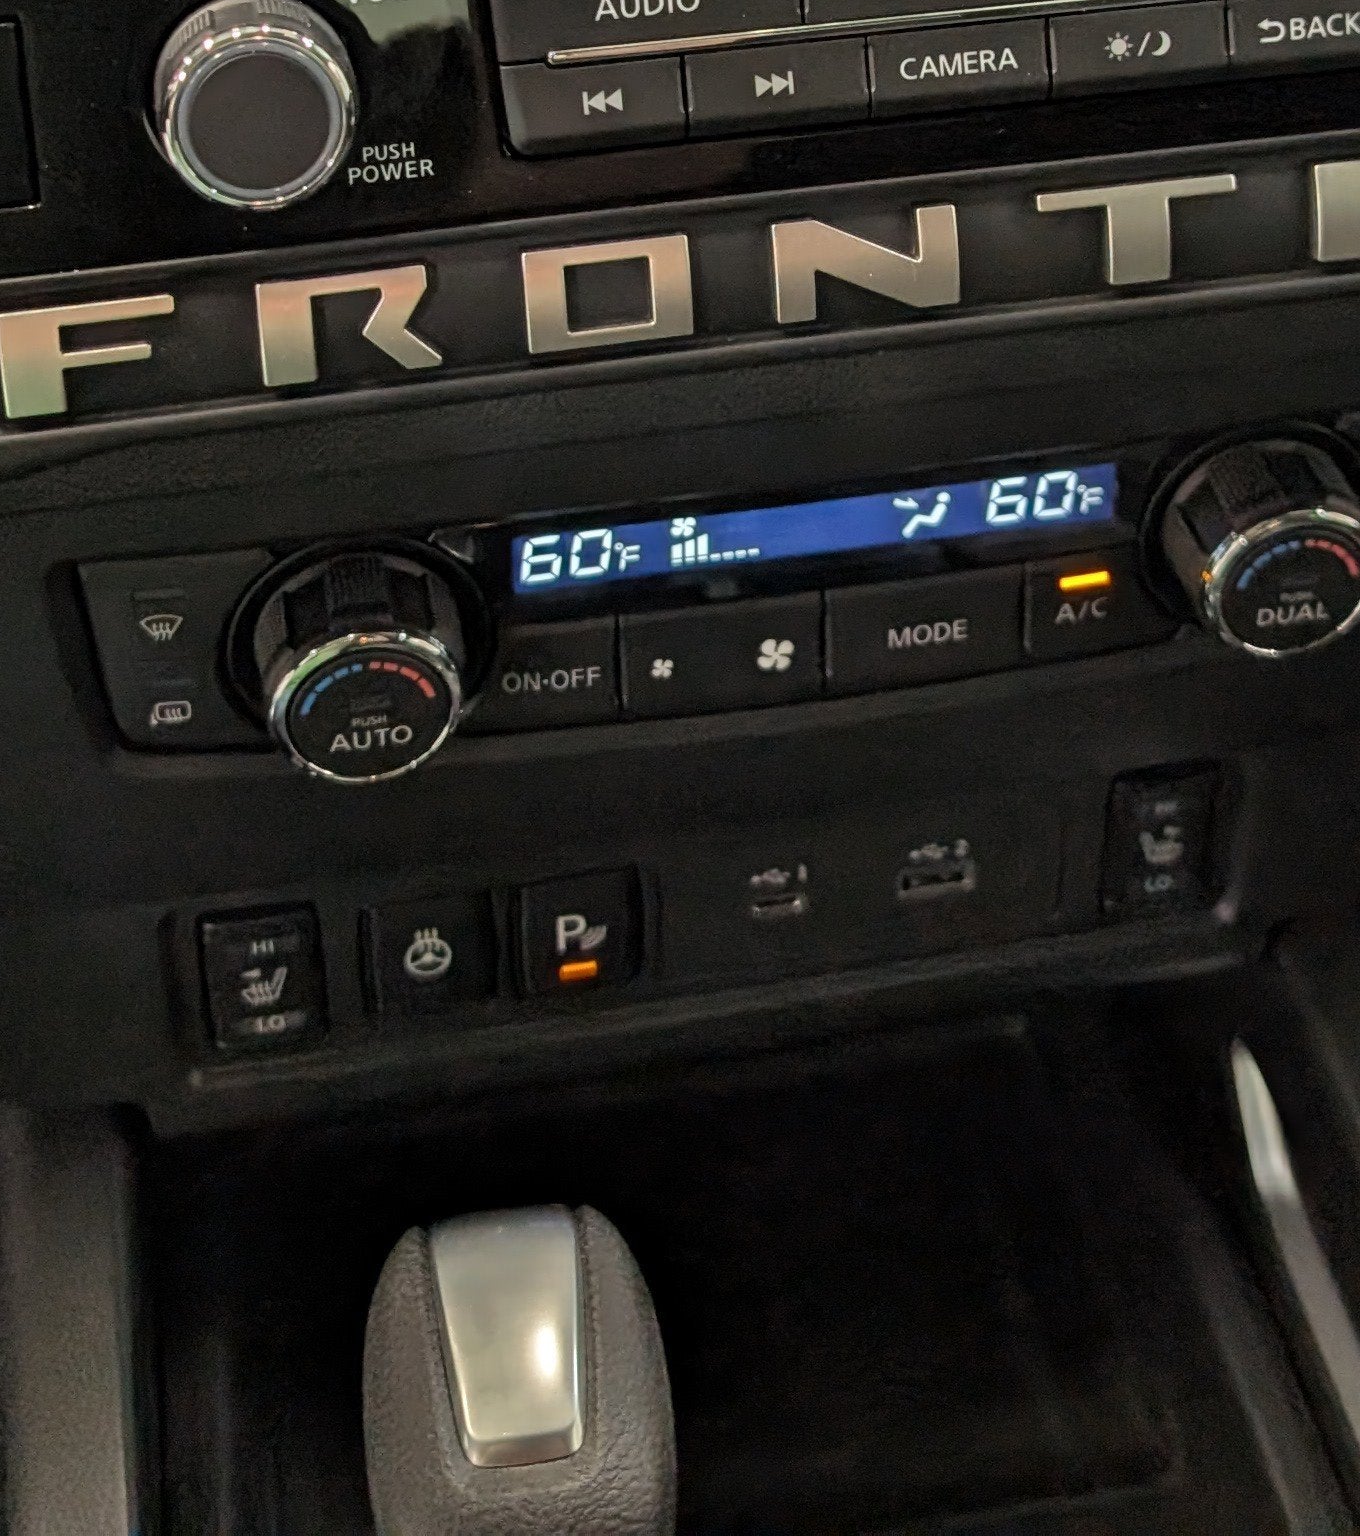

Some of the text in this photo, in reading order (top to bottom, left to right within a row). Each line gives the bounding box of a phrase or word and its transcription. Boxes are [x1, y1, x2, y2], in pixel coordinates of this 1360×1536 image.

[899, 47, 1019, 80] CAMERA
[362, 141, 416, 163] PUSH
[348, 158, 435, 186] POWER
[1054, 597, 1105, 624] A/C
[1256, 601, 1328, 627] DUAL
[887, 618, 968, 648] MODE
[329, 724, 413, 753] AUTO
